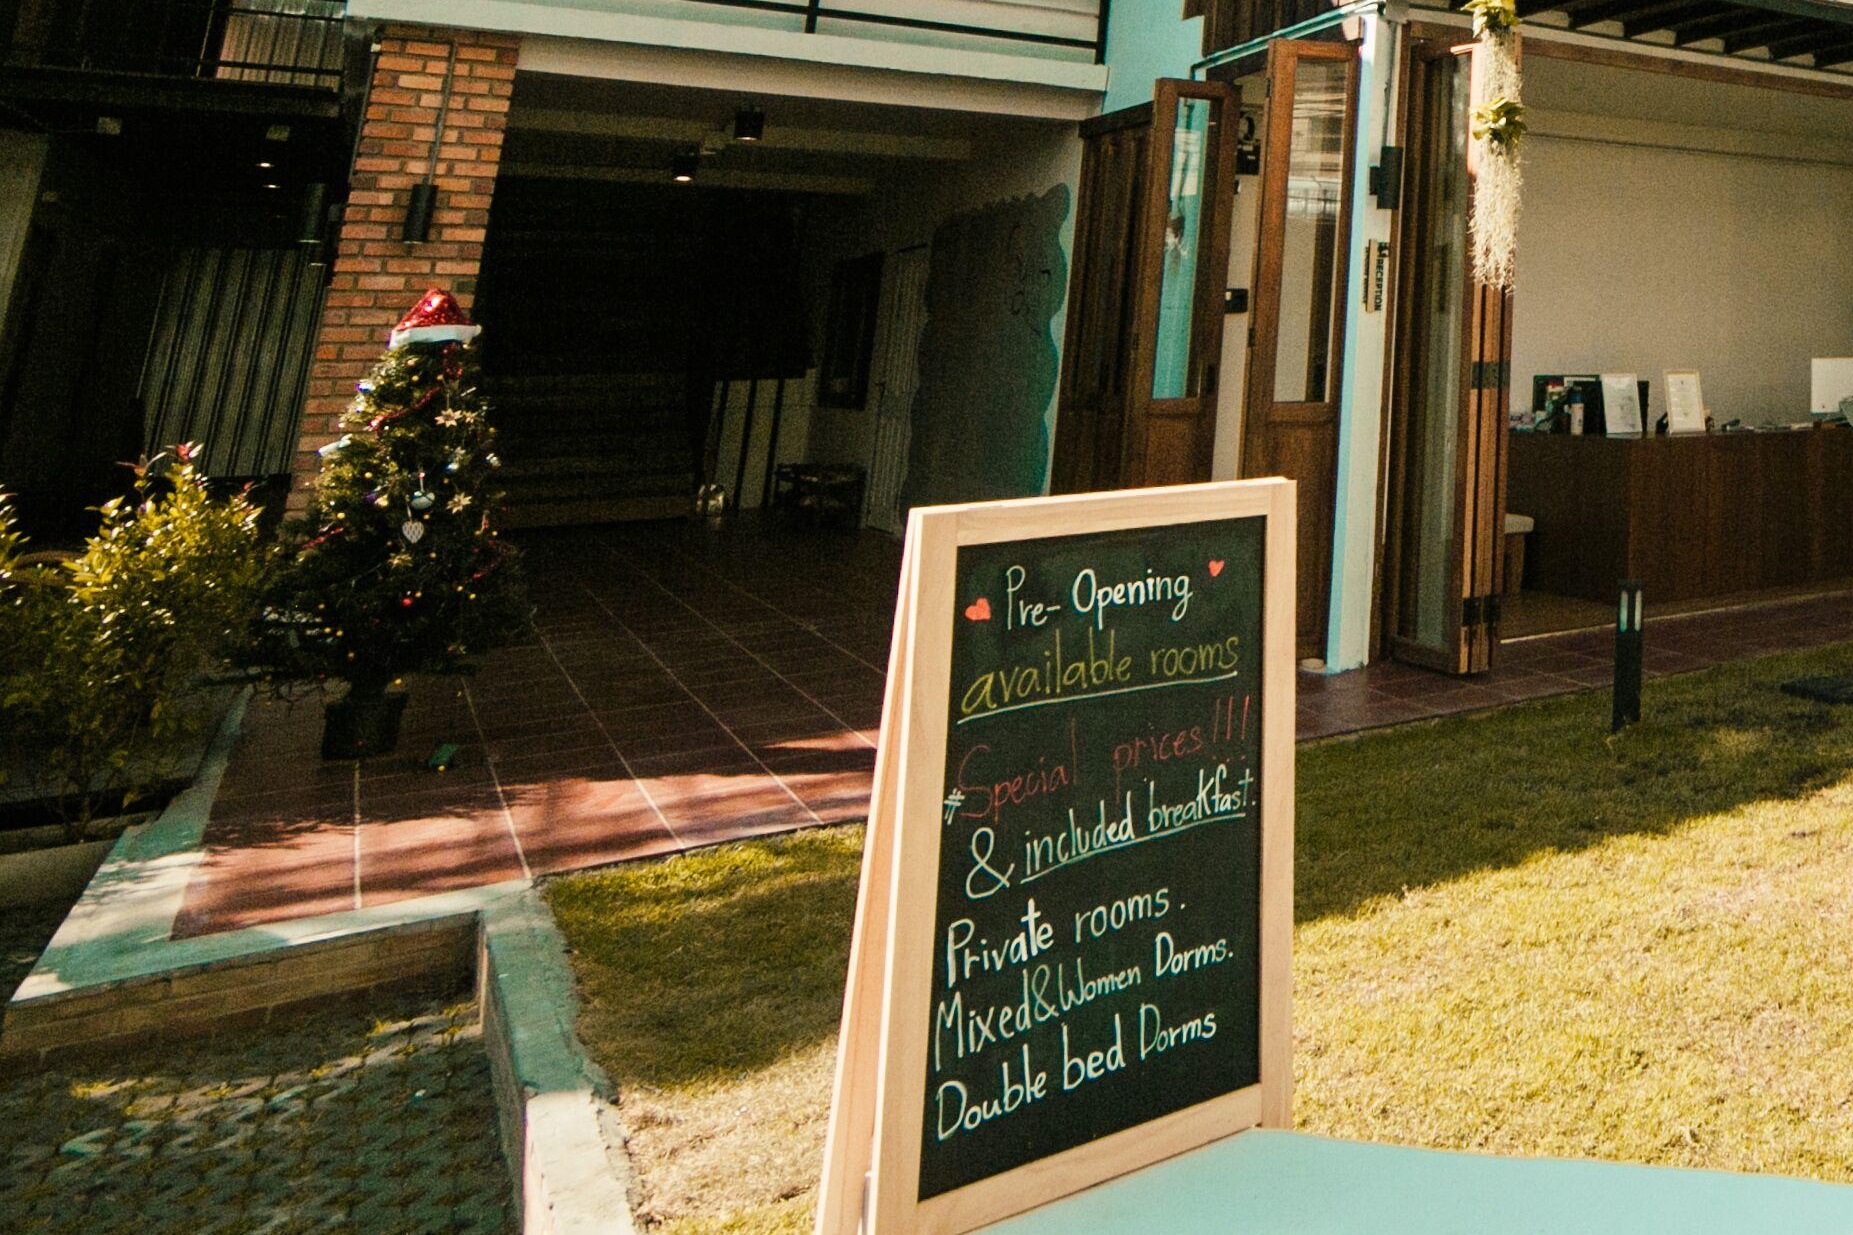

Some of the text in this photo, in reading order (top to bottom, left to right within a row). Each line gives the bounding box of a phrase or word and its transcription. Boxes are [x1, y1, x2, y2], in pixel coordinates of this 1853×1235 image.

[1374, 258, 1384, 311] RECEPTION
[1072, 569, 1193, 630] Opening
[962, 629, 1240, 714] available rooms
[957, 717, 1078, 823] Special
[965, 827, 1015, 898] &
[1025, 790, 1136, 876] included
[946, 898, 1054, 989] Private
[935, 1003, 1217, 1141] Double bed Dorms
